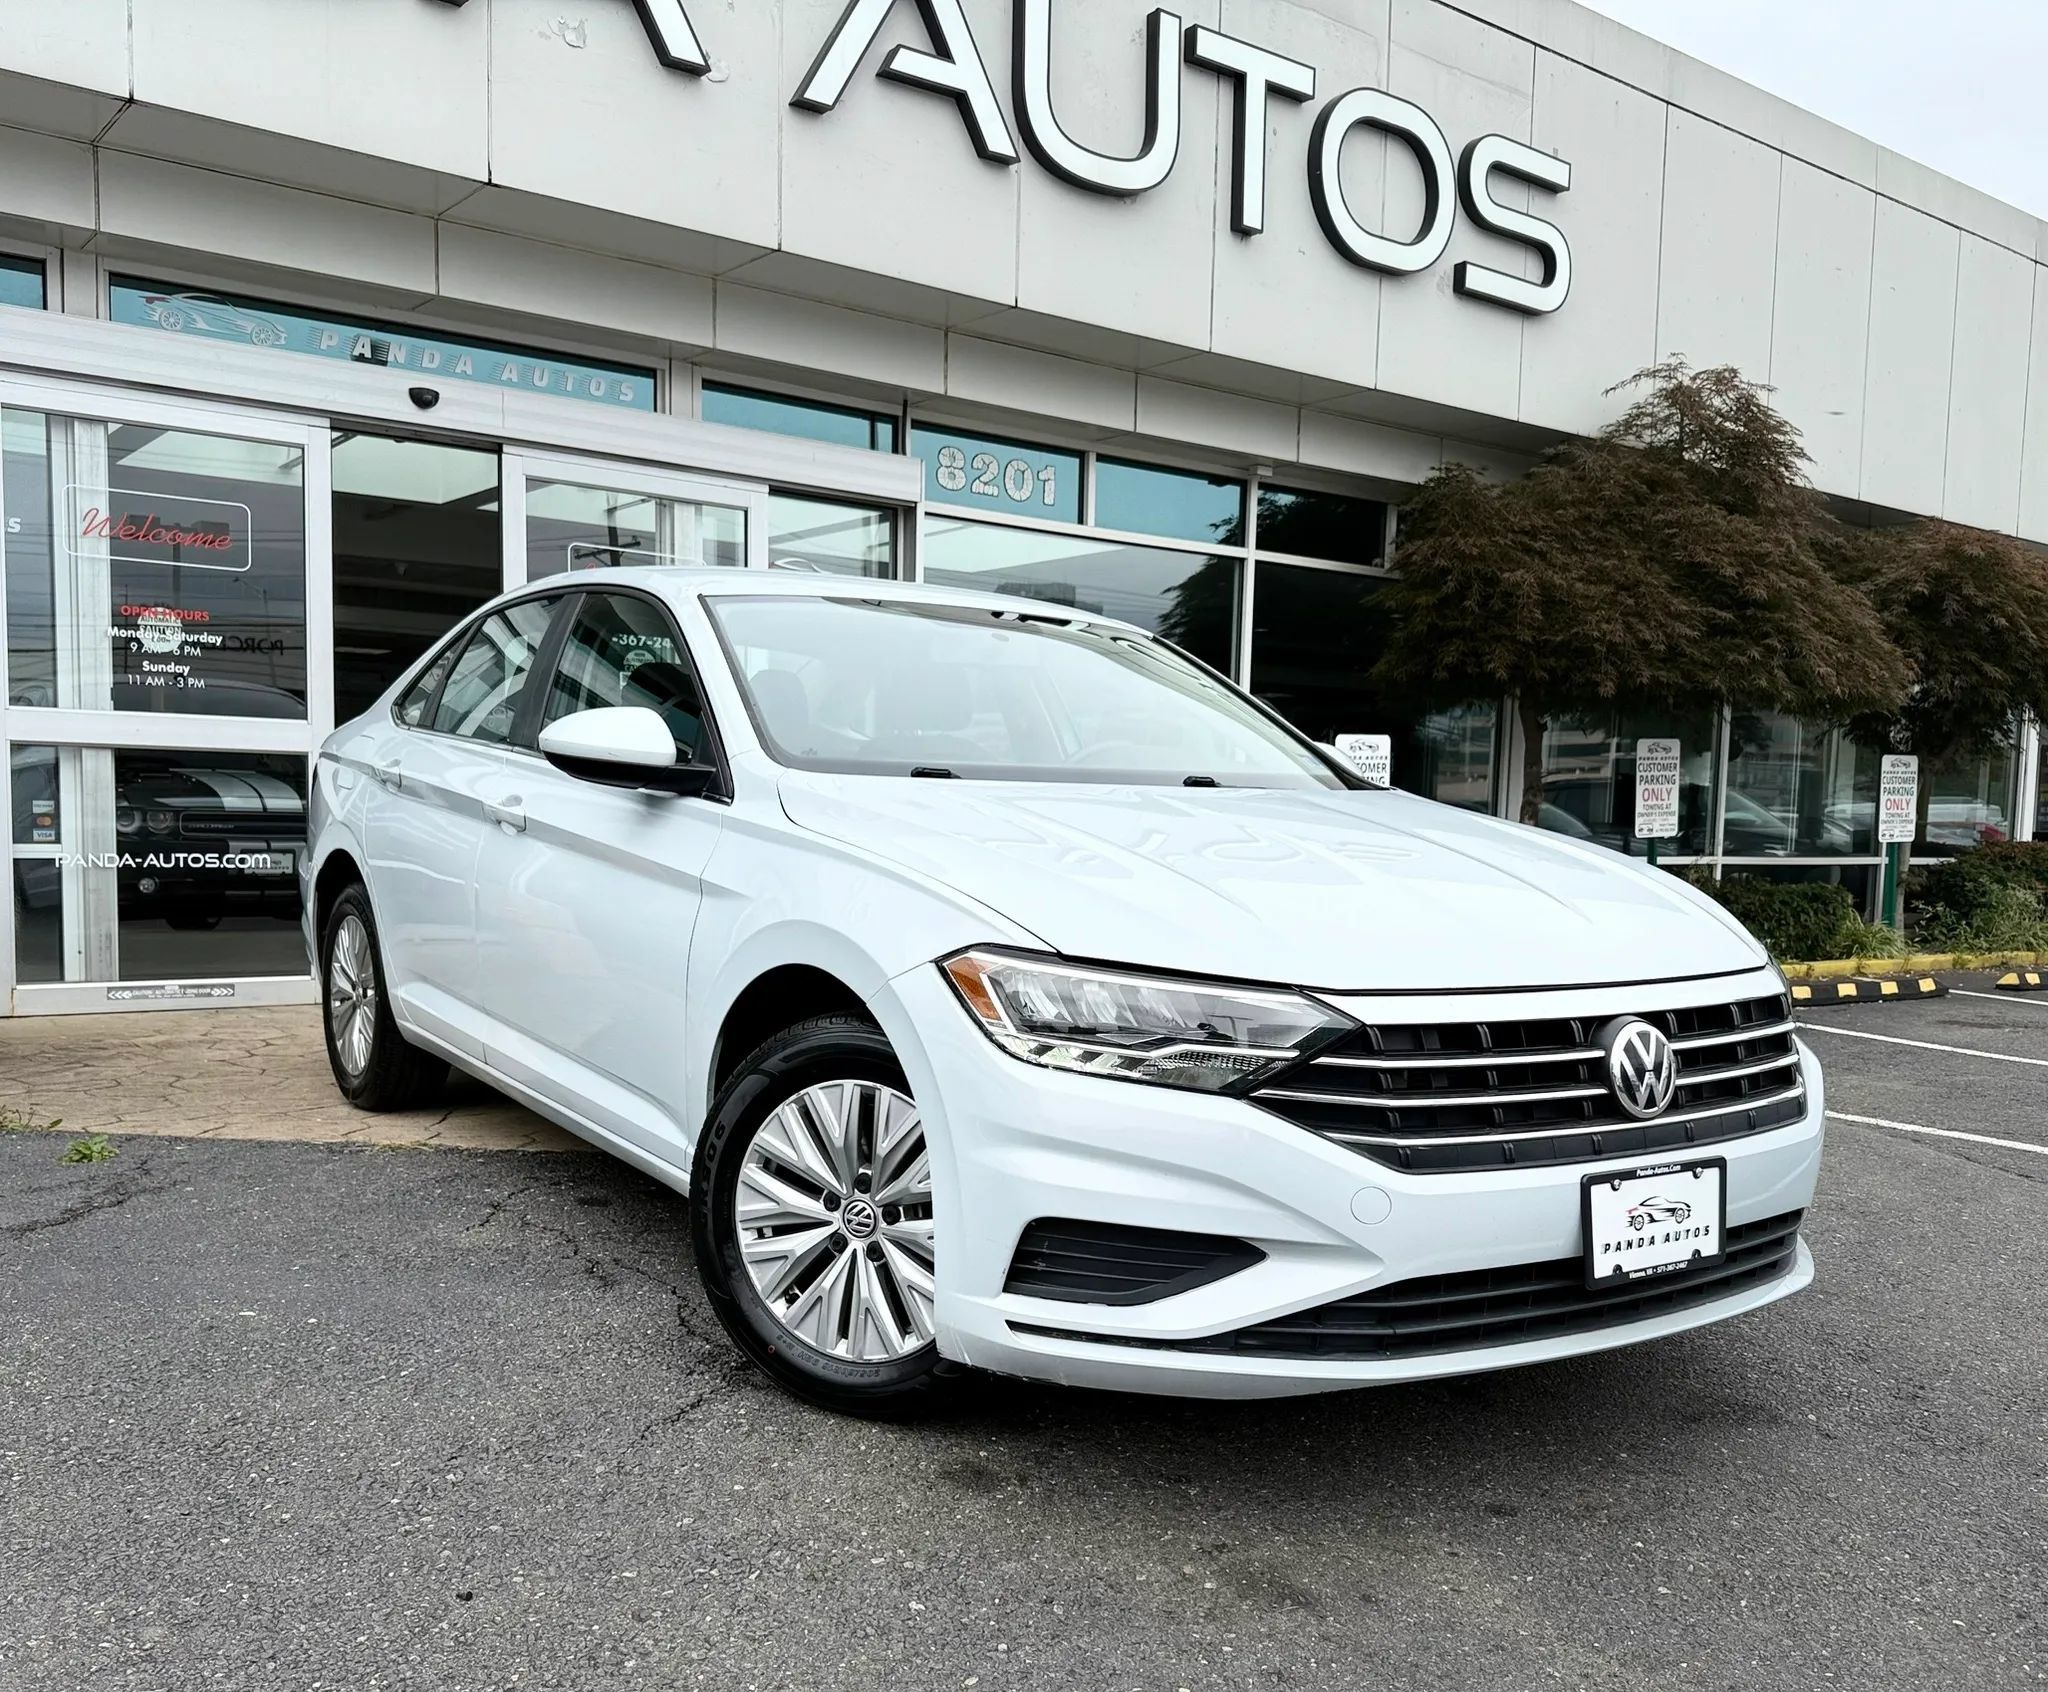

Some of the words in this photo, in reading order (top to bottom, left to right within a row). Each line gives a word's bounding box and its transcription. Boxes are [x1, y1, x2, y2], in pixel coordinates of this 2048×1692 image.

[790, 0, 1572, 315] AUTOS
[319, 328, 473, 376] PANDA
[501, 361, 635, 402] AUTOS
[935, 445, 1057, 507] 8201
[82, 507, 233, 550] Welcome
[121, 605, 157, 618] OPEN
[163, 608, 210, 621] HOURS
[130, 642, 138, 652] 9
[142, 646, 162, 654] AM
[173, 648, 181, 656] 6
[184, 645, 202, 656] PM
[611, 634, 673, 649] -367-24
[142, 660, 191, 677] Sunday
[128, 674, 141, 686] 11
[145, 676, 165, 686] AM
[176, 677, 184, 688] 3
[188, 677, 206, 689] PM
[1357, 762, 1387, 774] OMER
[1637, 762, 1678, 773] CUSTOMER
[1639, 773, 1676, 786] PARKING
[1882, 775, 1916, 785] CUSTOMER
[1642, 787, 1673, 802] ONLY
[1882, 786, 1915, 797] PARKING
[1642, 803, 1664, 811] TOWING
[1885, 797, 1911, 811] ONLY
[1603, 1235, 1656, 1255] PANDA
[1663, 1225, 1710, 1244] AUTOS
